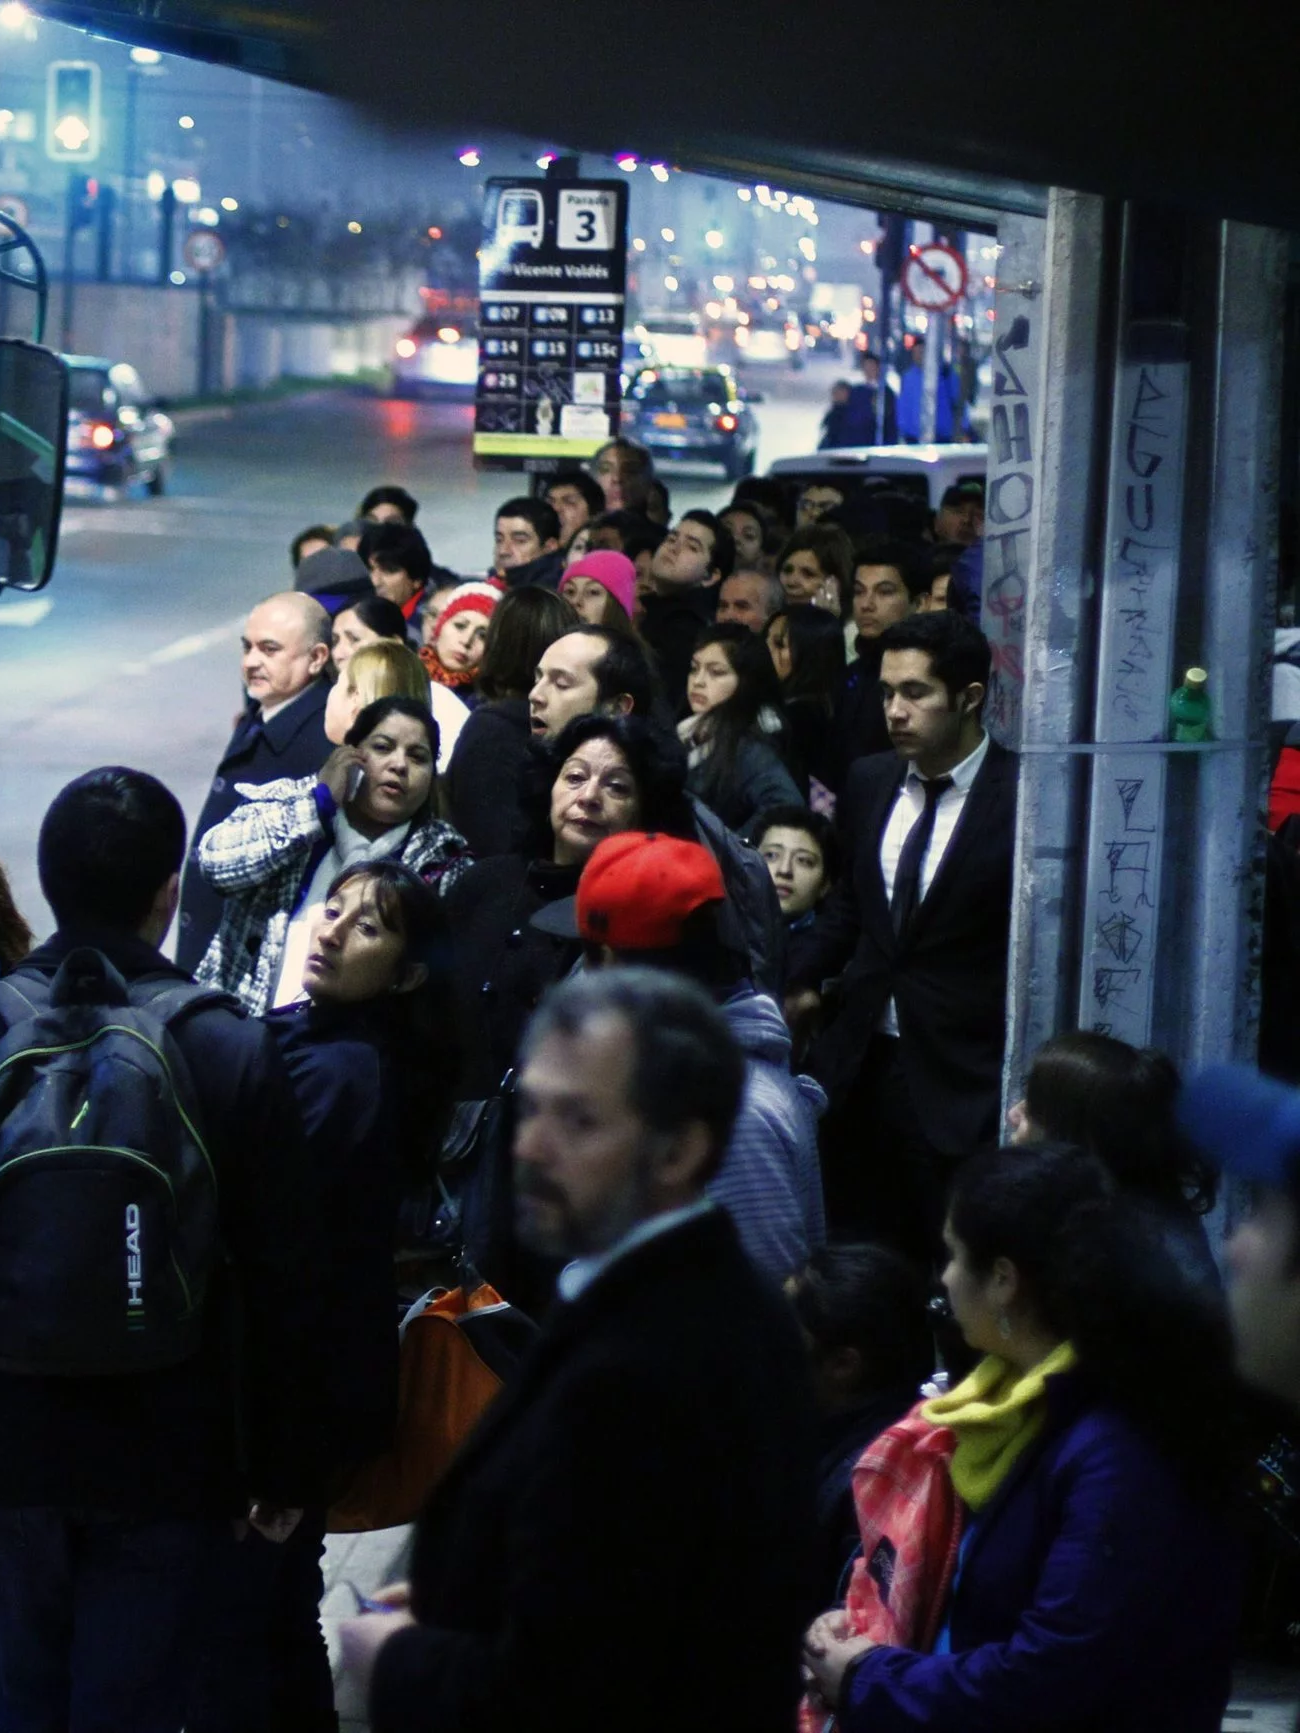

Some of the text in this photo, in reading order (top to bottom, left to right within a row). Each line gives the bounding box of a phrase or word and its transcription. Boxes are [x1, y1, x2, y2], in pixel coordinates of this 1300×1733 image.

[576, 210, 596, 242] 3
[513, 263, 562, 278] Vicente
[125, 1203, 143, 1306] HEAD
